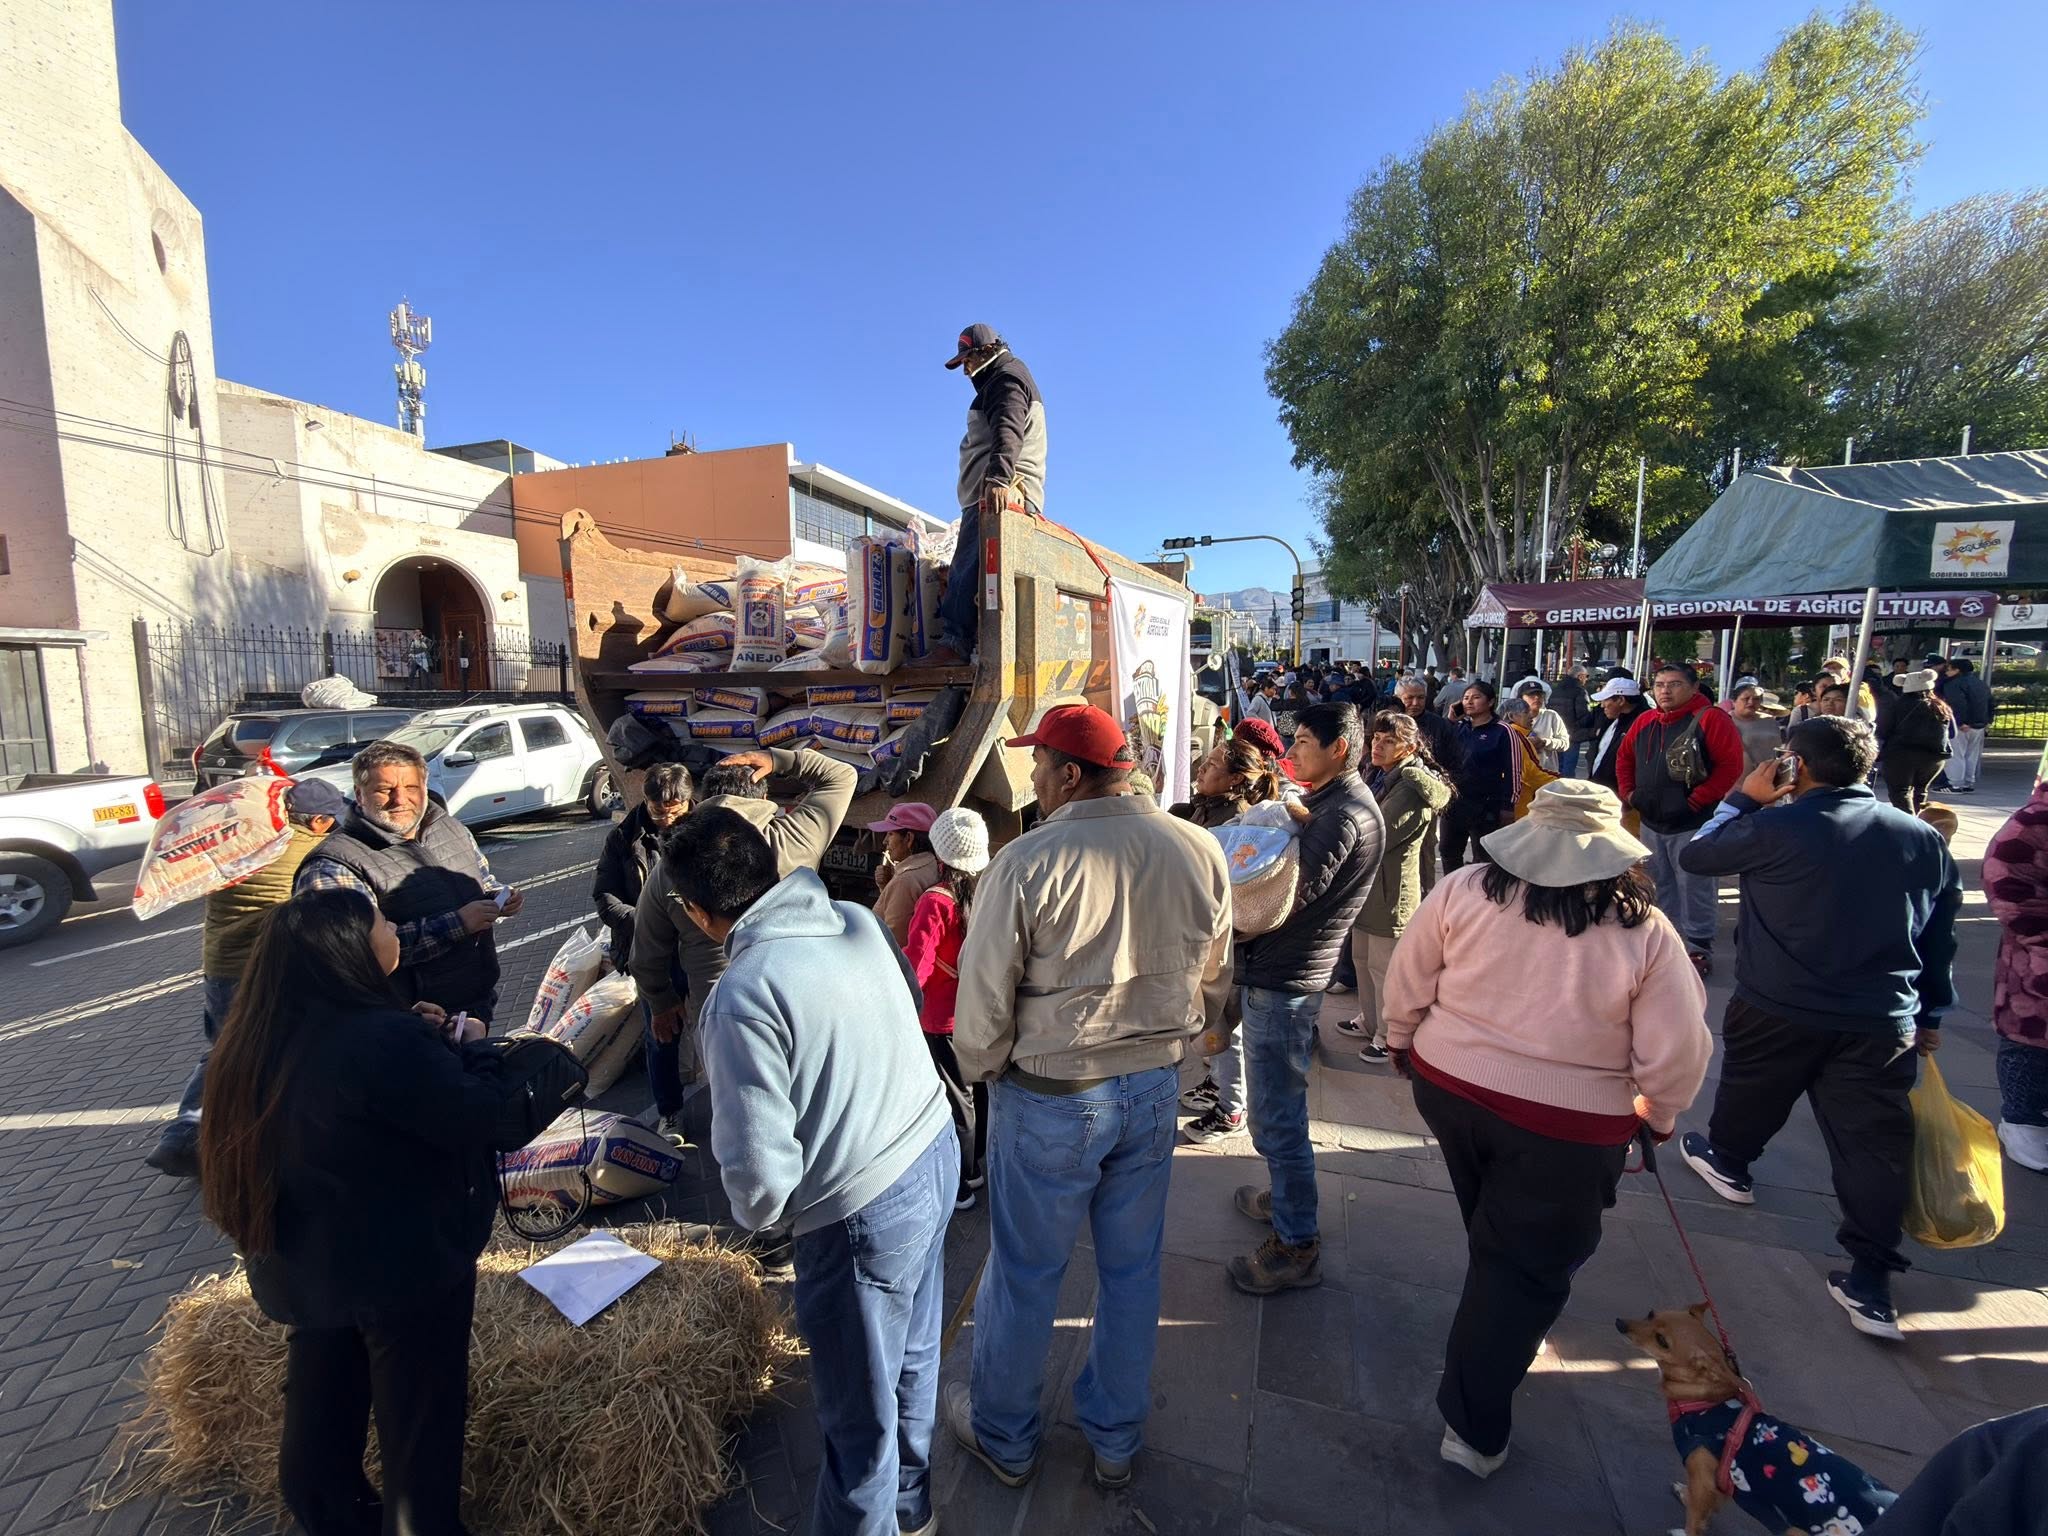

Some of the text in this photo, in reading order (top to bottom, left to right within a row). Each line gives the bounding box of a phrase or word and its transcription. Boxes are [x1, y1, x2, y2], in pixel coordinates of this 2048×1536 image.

[1546, 599, 1950, 624] GERENCIA REGIONAL DE AGRICLTURA
[736, 651, 783, 663] AÑEJO
